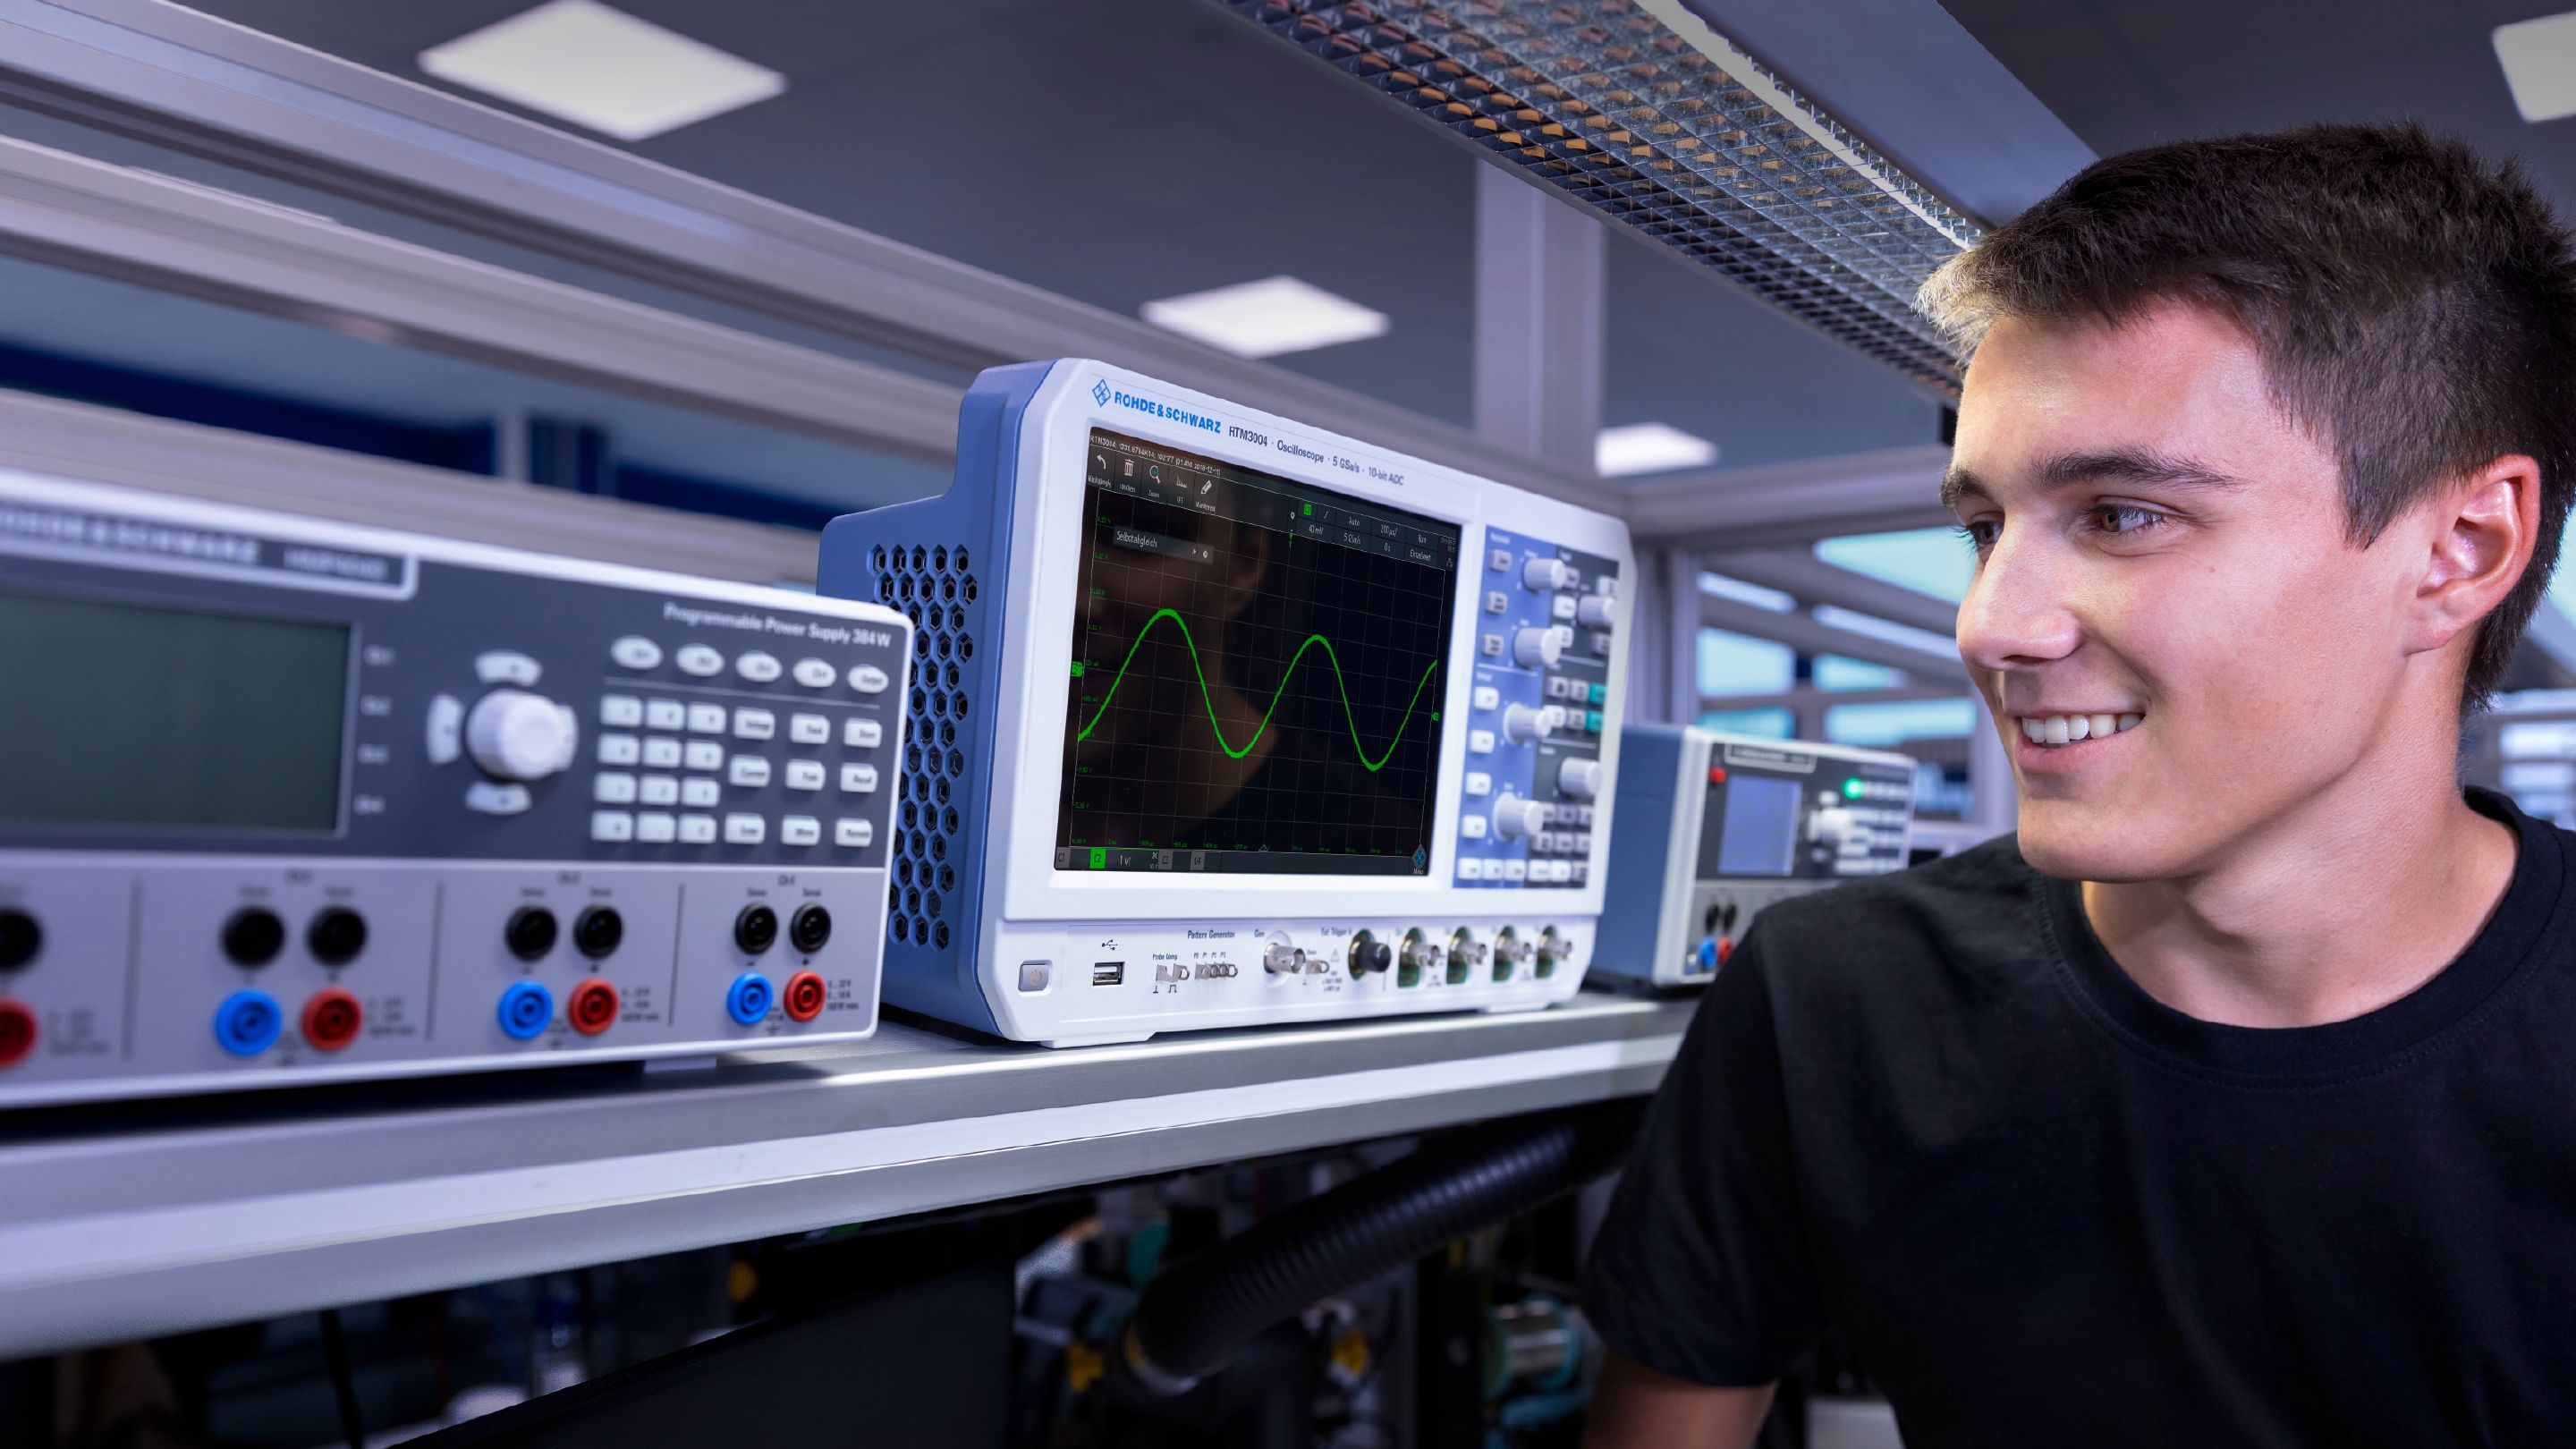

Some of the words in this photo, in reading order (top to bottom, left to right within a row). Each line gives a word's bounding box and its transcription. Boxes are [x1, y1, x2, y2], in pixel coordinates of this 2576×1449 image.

[1229, 426, 1267, 447] RTM3004
[1276, 439, 1324, 462] Oscilloscope
[1332, 455, 1338, 467] 5
[1339, 458, 1360, 473] GSa/s
[1368, 466, 1387, 481] 10-bit
[1388, 472, 1404, 486] ADC
[1348, 516, 1360, 527] Auto
[664, 602, 762, 630] Programmable
[765, 617, 806, 637] Power
[808, 623, 850, 645] Supply
[1187, 929, 1208, 939] Pattern
[1208, 928, 1236, 939] Generator
